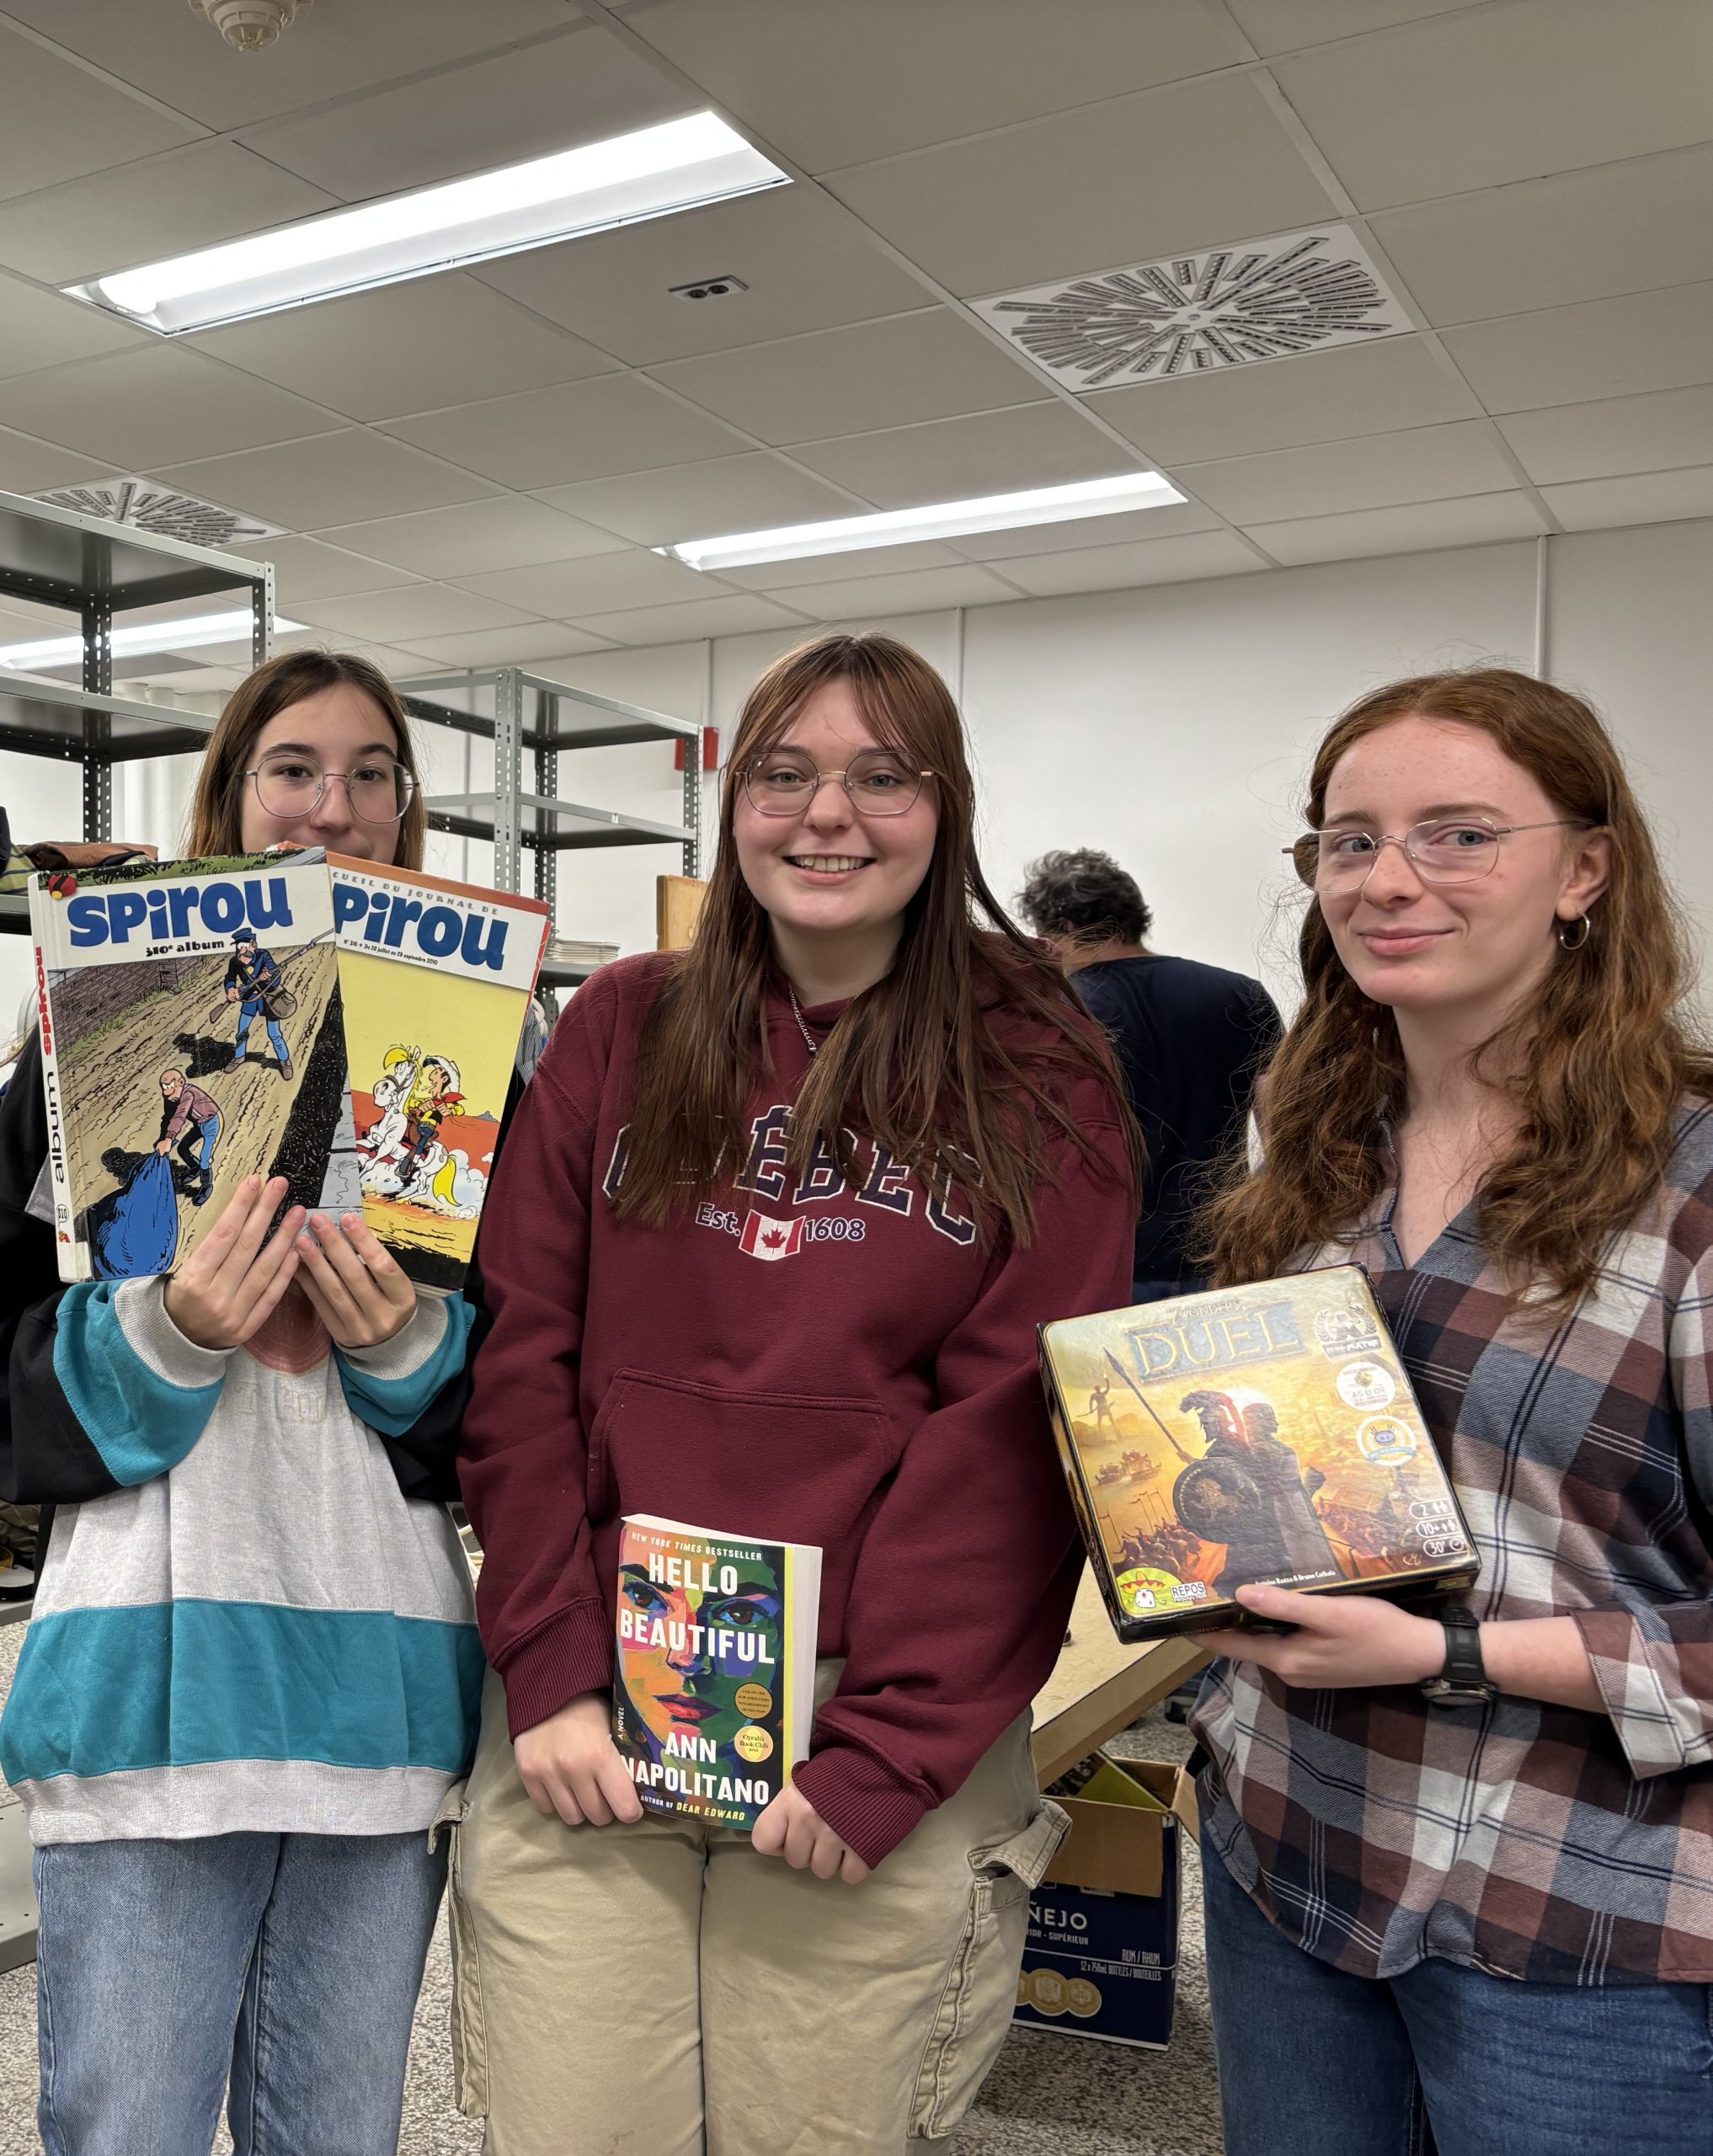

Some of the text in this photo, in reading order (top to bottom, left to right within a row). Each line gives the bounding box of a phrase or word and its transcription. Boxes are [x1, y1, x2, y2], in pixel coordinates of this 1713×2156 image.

[332, 871, 499, 915] CUEIL DU JOURNAL DE
[176, 940, 225, 953] album
[403, 953, 426, 963] septembre
[46, 1071, 65, 1184] album
[694, 1201, 866, 1241] Est. 1608
[1133, 1310, 1298, 1375] DUEL
[1419, 1503, 1430, 1517] 2
[1421, 1522, 1441, 1536] 10+
[631, 1531, 762, 1561] NEW YORK TIMES BESTSELLER
[1429, 1540, 1445, 1555] 30'
[648, 1552, 739, 1596] HELLO
[1171, 1582, 1204, 1598] REPOS
[620, 1607, 775, 1665] BEAUTIFUL
[664, 1732, 717, 1764] ANN
[739, 1740, 755, 1748] Book
[742, 1733, 765, 1742] Oprah's
[620, 1754, 770, 1806] NAPOLITANO
[640, 1795, 664, 1806] AUTHOR
[676, 1801, 700, 1814] DEAR
[704, 1806, 745, 1821] EDWARD
[1028, 1901, 1088, 1930] ÑEJO
[1122, 1948, 1136, 1963] RUM
[1141, 1951, 1161, 1966] RHUM
